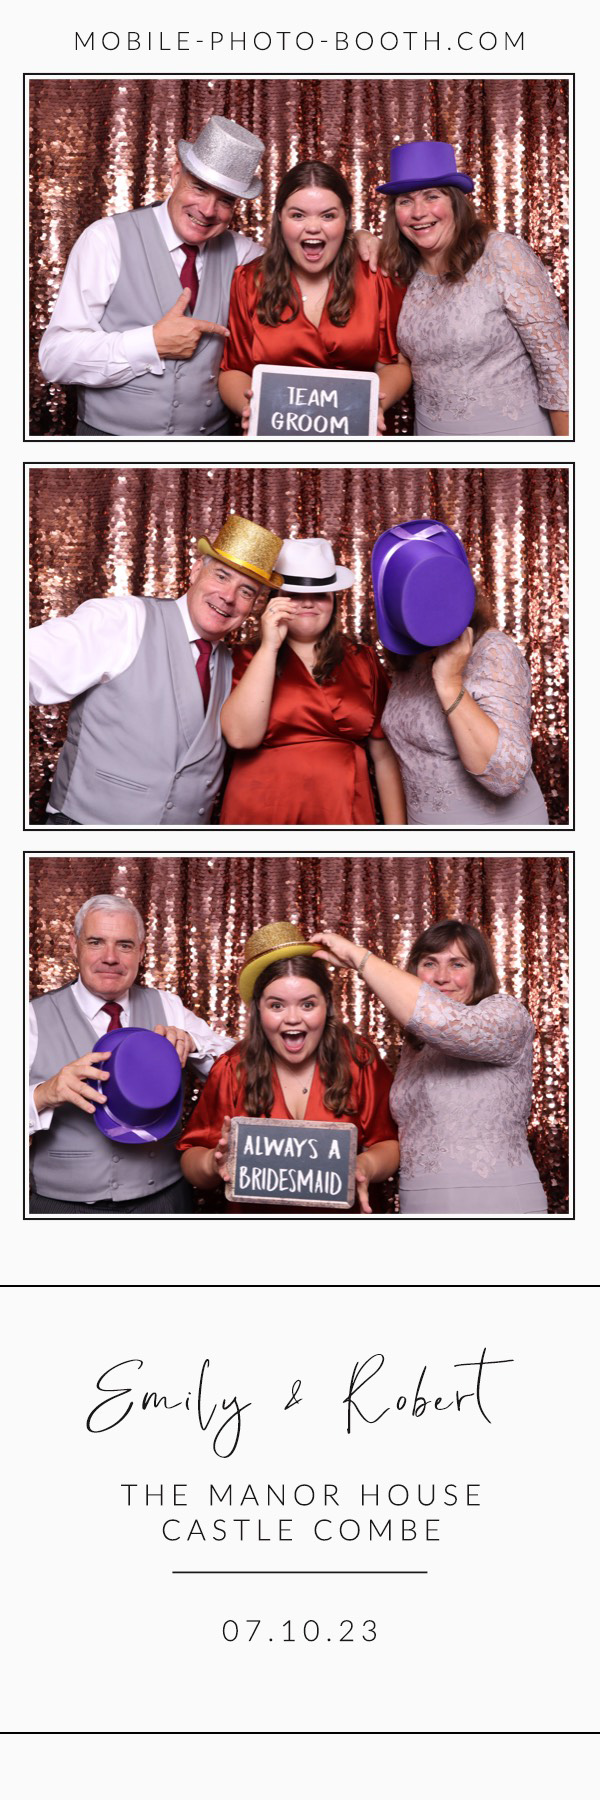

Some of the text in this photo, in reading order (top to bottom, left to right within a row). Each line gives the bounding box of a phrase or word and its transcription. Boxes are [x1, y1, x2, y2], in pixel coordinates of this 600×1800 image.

[287, 386, 338, 409] TEAM
[271, 411, 349, 435] GROOM
[243, 1135, 341, 1160] ALWAYS A
[239, 1165, 342, 1196] BRIDESMAID
